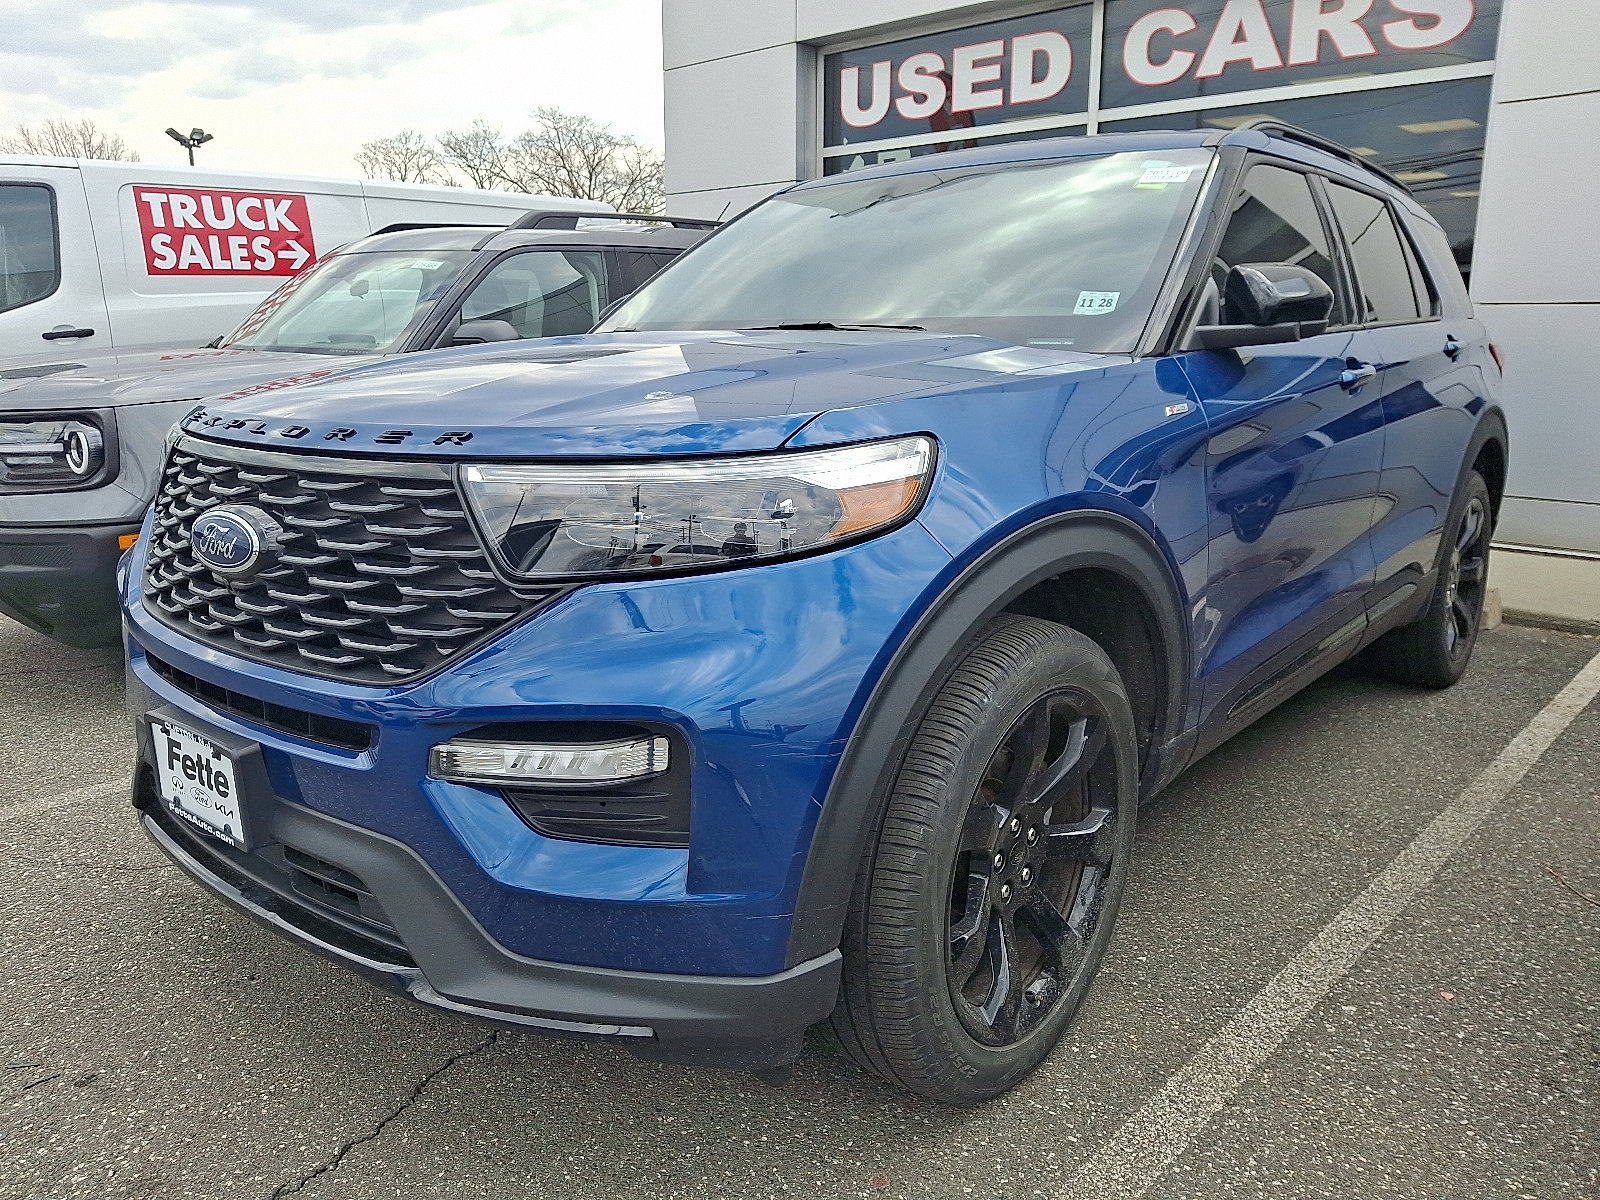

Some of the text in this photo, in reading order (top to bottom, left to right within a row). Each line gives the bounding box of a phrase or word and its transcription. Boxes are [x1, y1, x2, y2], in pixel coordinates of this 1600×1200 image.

[840, 0, 1476, 128] USED CARS
[140, 192, 300, 232] TRUCK
[149, 233, 276, 271] SALES
[1079, 298, 1113, 308] 11 28
[189, 411, 474, 446] EXPLORER
[199, 523, 237, 559] Ford
[166, 736, 230, 799] Fette
[169, 802, 235, 847] FetteAuto.com
